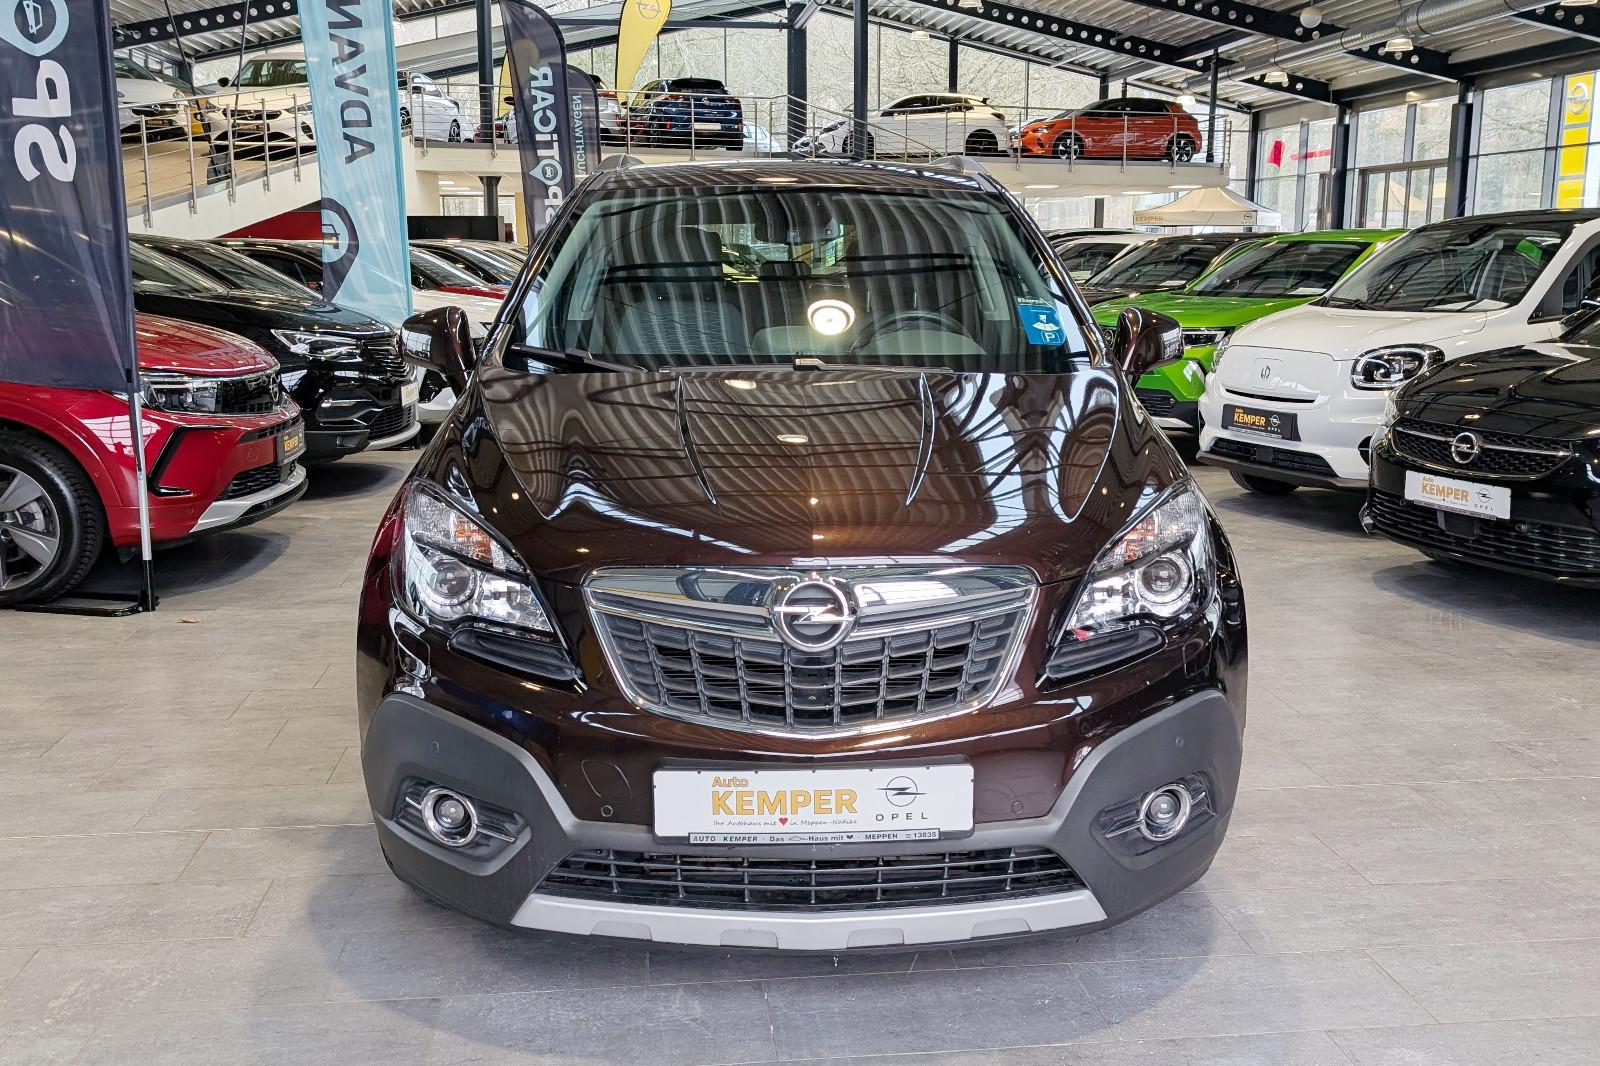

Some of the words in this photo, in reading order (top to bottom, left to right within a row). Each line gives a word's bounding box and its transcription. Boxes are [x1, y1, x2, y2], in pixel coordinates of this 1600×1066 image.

[1233, 412, 1266, 427] KEMPER
[1421, 482, 1469, 503] KEMPER
[712, 776, 749, 788] Auto
[711, 788, 858, 816] KEMPER
[875, 812, 928, 822] OPEL
